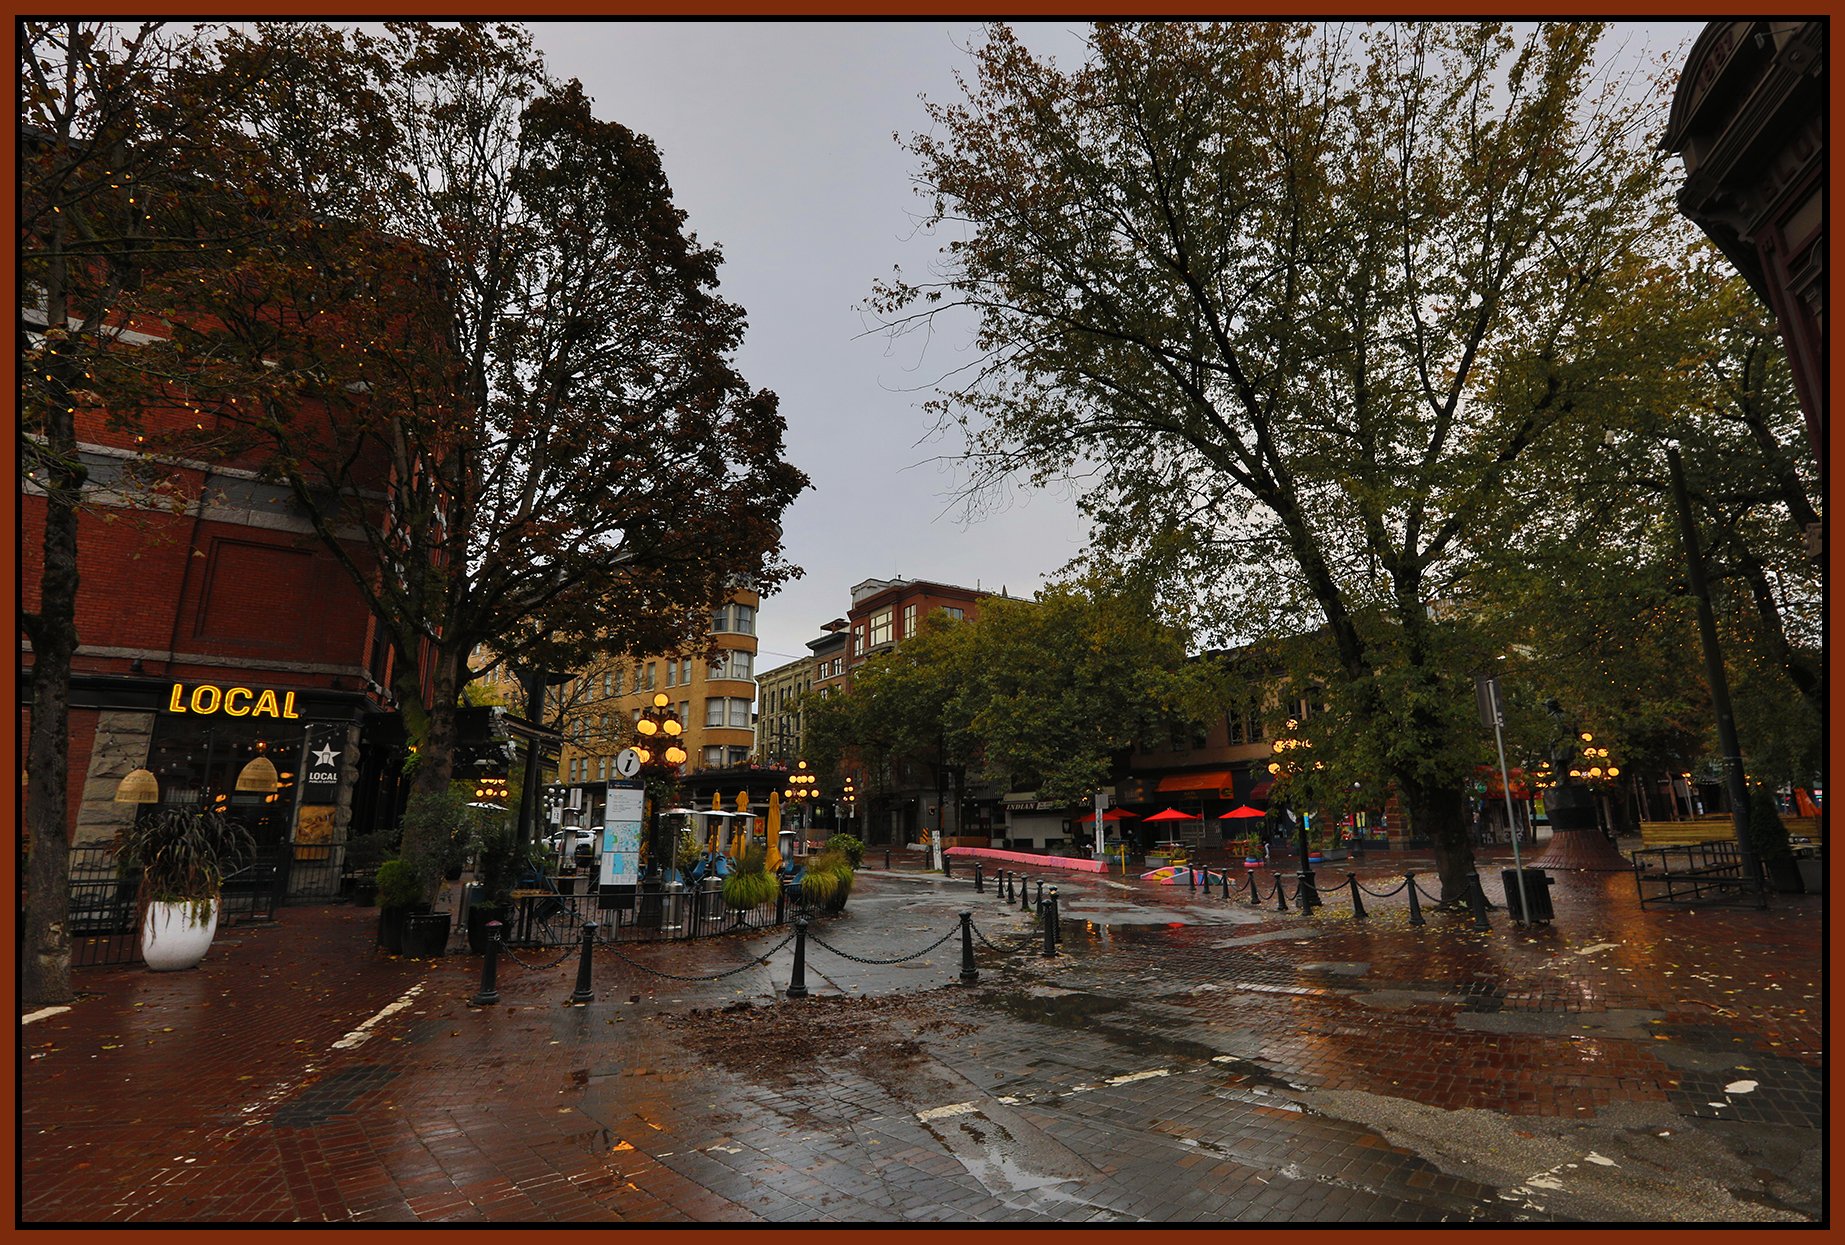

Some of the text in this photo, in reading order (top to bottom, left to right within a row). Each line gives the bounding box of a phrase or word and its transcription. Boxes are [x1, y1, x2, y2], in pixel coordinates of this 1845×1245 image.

[169, 683, 300, 719] LOCAL
[309, 772, 338, 781] LOCAL
[1006, 803, 1036, 811] INDIAN
